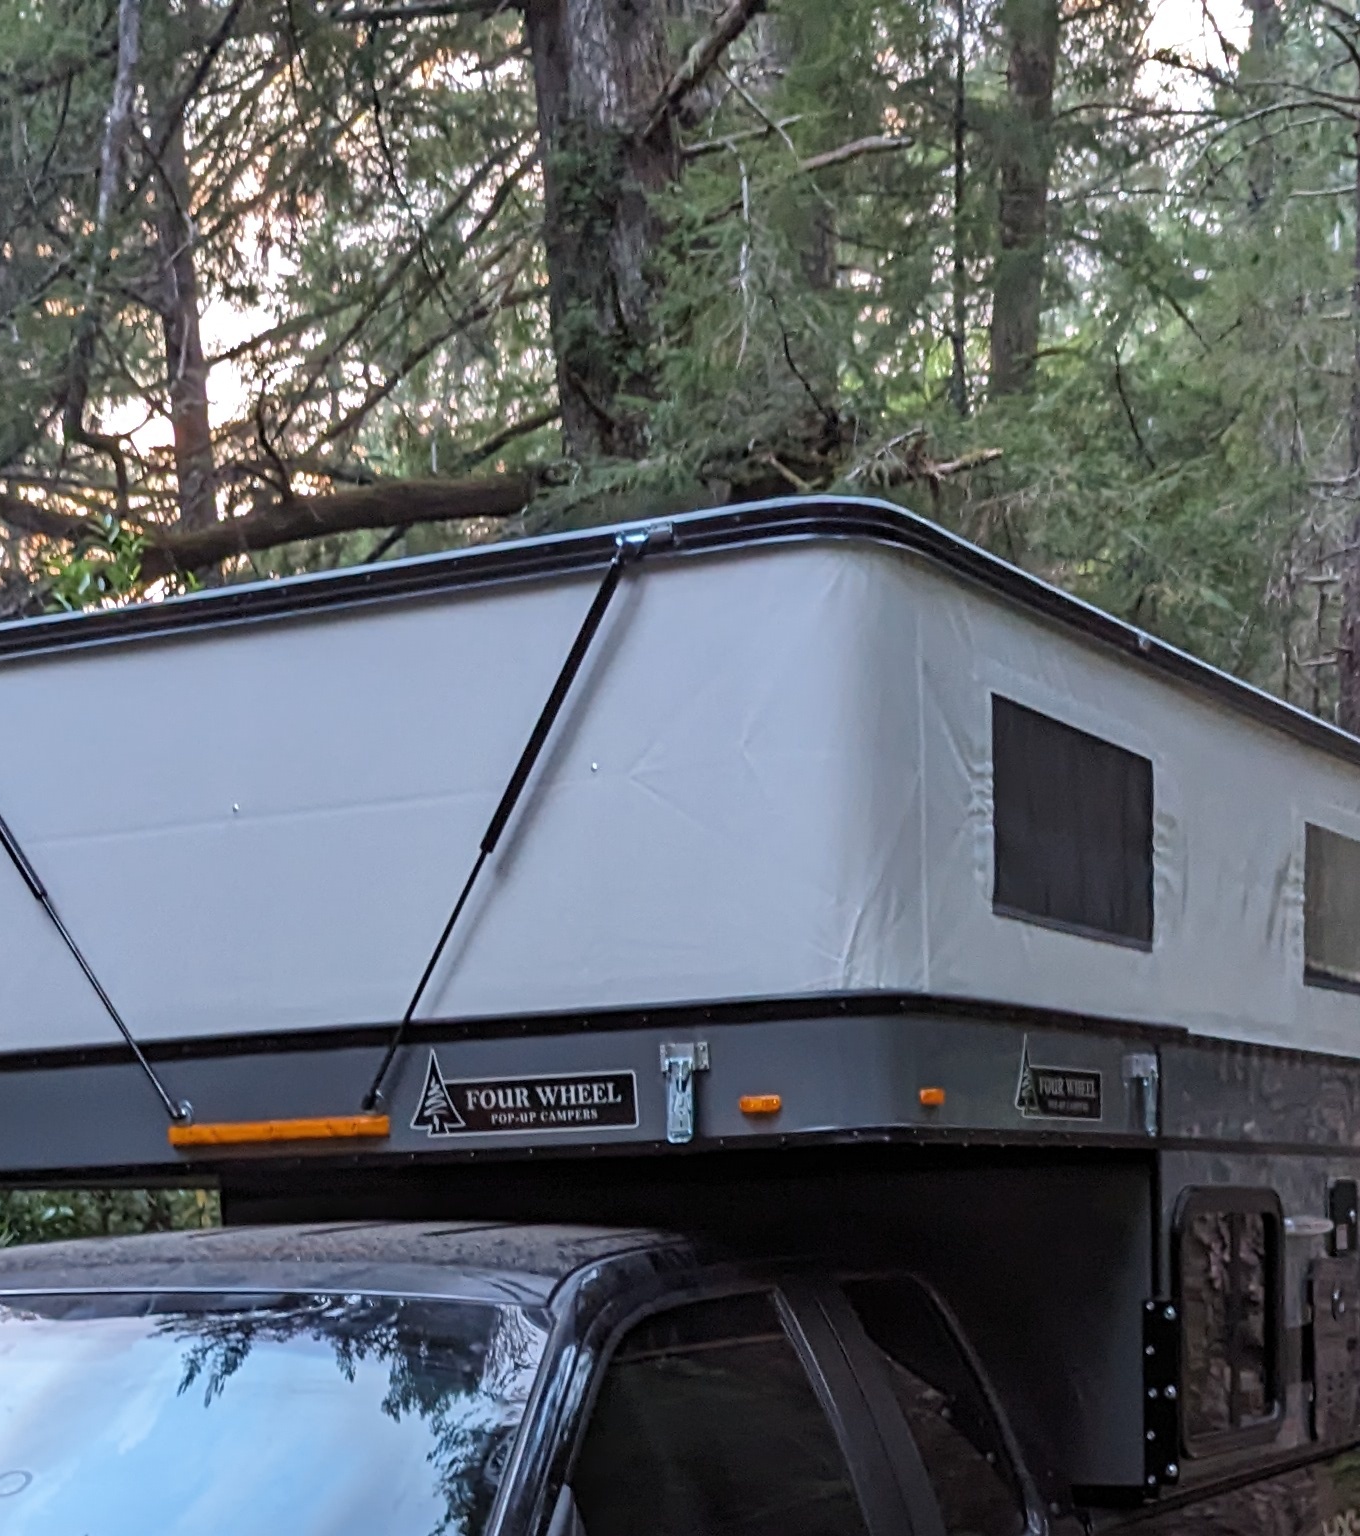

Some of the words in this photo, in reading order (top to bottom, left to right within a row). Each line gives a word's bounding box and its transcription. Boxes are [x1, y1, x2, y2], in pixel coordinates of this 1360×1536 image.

[465, 1087, 530, 1111] FOUR
[534, 1082, 622, 1107] WHEEL
[1039, 1076, 1064, 1096] FOUR
[1065, 1078, 1096, 1099] WHEEL
[490, 1111, 536, 1125] POP-UP
[540, 1108, 598, 1123] CAMPERS
